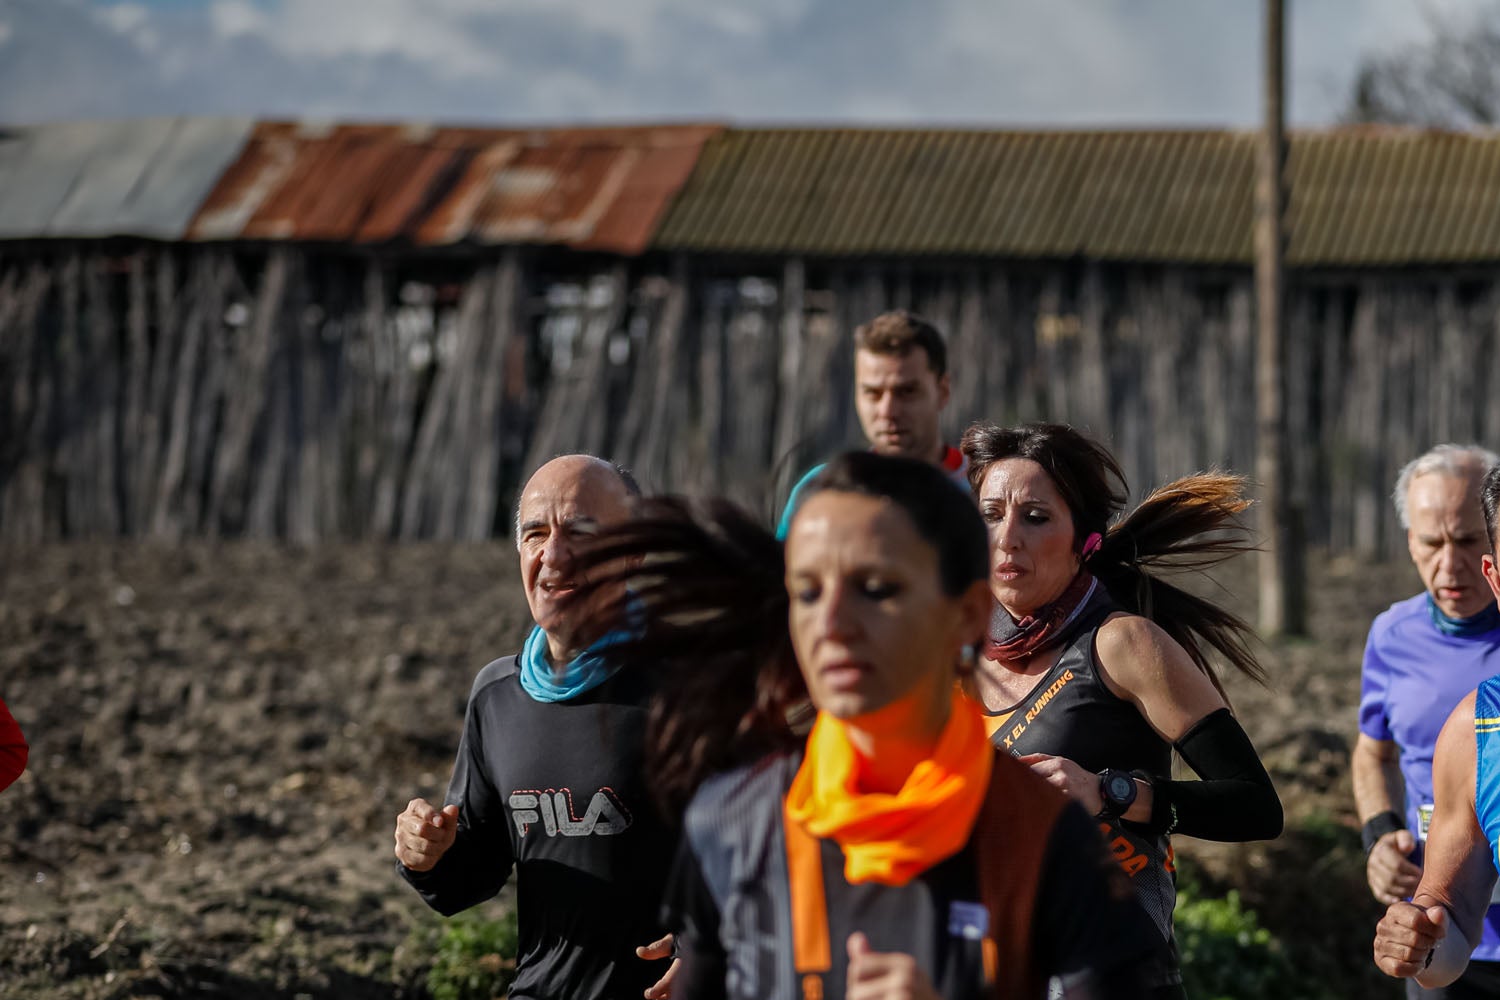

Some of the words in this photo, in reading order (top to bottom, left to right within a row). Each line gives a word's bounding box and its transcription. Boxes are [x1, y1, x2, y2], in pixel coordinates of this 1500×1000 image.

[1012, 723, 1026, 740] EL
[1025, 669, 1074, 724] RUNNING
[508, 789, 628, 838] FILA
